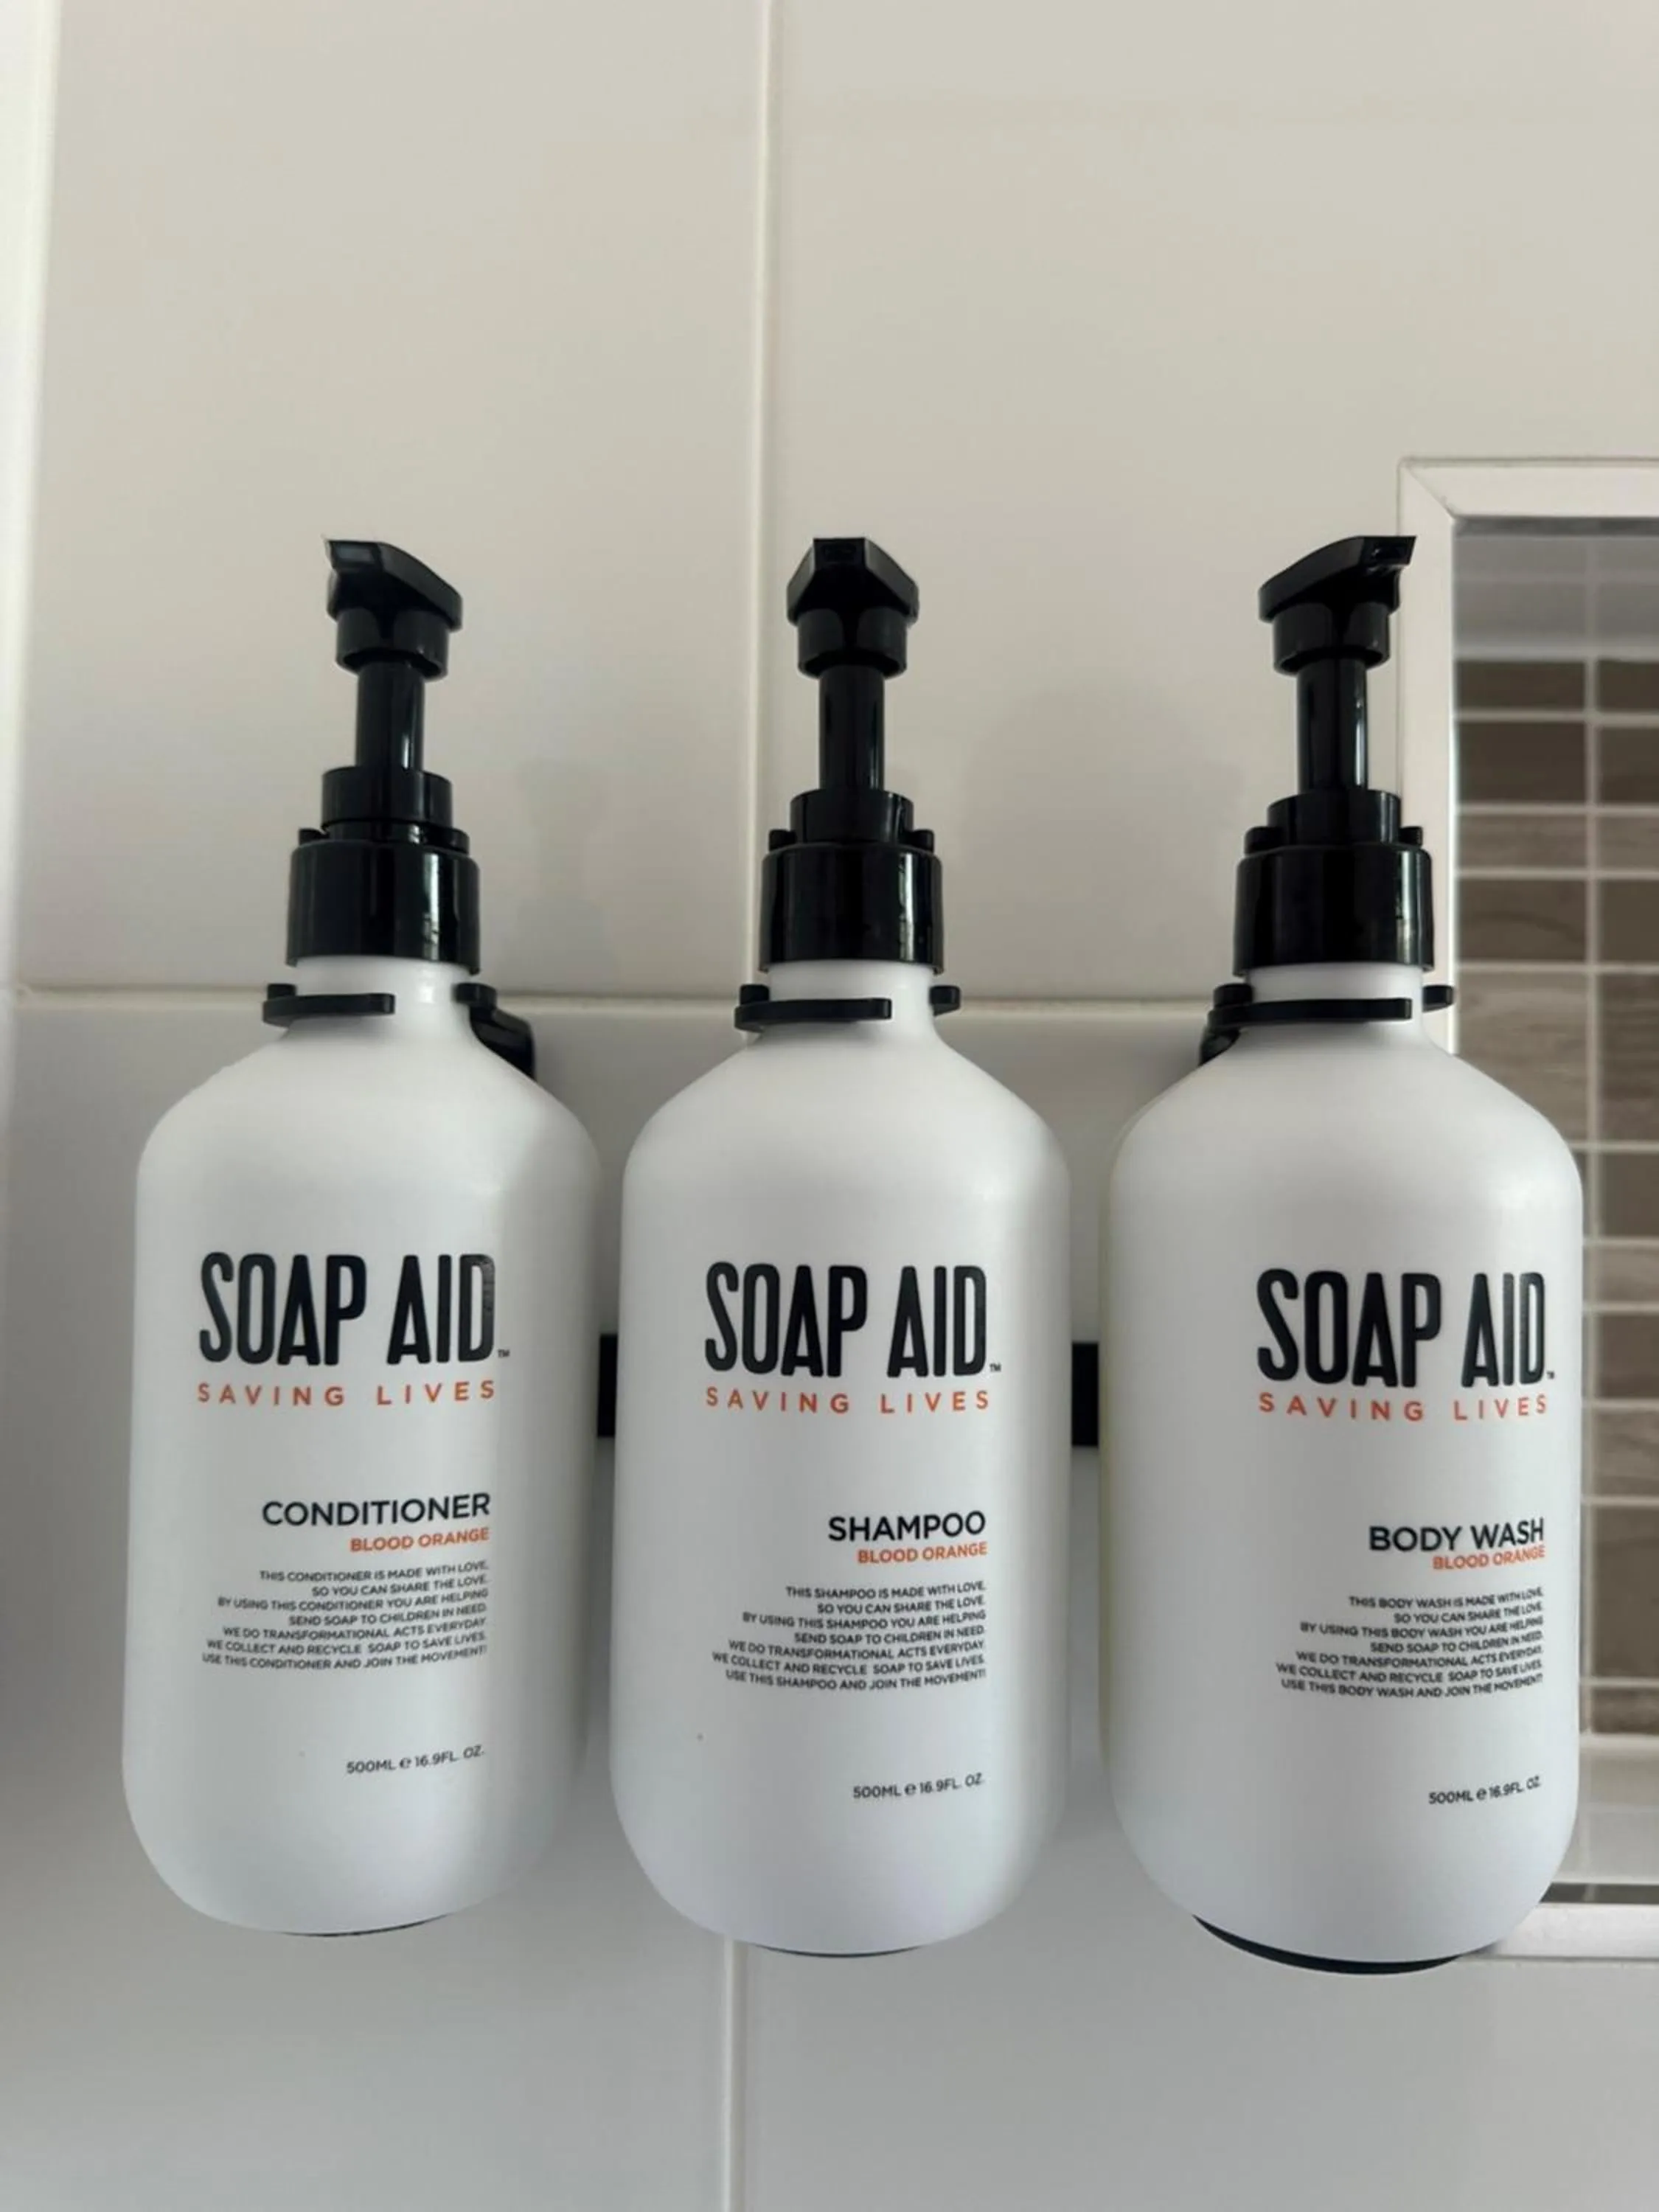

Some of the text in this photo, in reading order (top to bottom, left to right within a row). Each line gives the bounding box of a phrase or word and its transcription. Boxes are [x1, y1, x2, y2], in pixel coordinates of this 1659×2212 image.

[199, 1252, 366, 1366] SOAP
[386, 1253, 495, 1365] AID
[705, 1262, 867, 1377] SOAP
[887, 1265, 987, 1377] AID
[1257, 1268, 1545, 1388] SOAP AID
[198, 1380, 495, 1406] SAVING LIVES
[706, 1386, 989, 1414] SAVING LIVES
[1259, 1391, 1547, 1422] SAVING LIVES
[262, 1492, 491, 1526] CONDITIONER
[828, 1510, 986, 1542] SHAMPOO
[1369, 1517, 1543, 1552] BODY WASH
[350, 1527, 490, 1552] BLOOD ORANGE
[858, 1541, 988, 1564] BLOOD ORANGE
[1433, 1545, 1545, 1570] BLOOD ORANGE
[260, 1565, 455, 1582] THIS CONDITIONER IS MADE WITH
[311, 1586, 329, 1596] SO
[332, 1586, 358, 1596] YOU
[361, 1585, 387, 1596] CAN
[390, 1582, 429, 1594] SHARE
[434, 1579, 454, 1590] THE
[785, 1584, 955, 1599] THIS SHAMPOO IS MADE WITH
[218, 1587, 489, 1611] BY USING THIS CONDITIONER YOU ARE HELPING
[817, 1603, 834, 1614] SO
[837, 1604, 863, 1614] YOU
[865, 1603, 891, 1614] CAN
[894, 1601, 931, 1613] SHARE
[934, 1599, 954, 1610] THE
[1349, 1594, 1495, 1608] THIS BODY WASH MADE
[289, 1607, 453, 1626] SEND SOAP TO CHILDREN IN
[742, 1610, 986, 1630] BY USING THIS SHAMPOO YOU ARE HELPING
[1394, 1608, 1500, 1624] SO YOU CAN SHARE
[223, 1624, 425, 1640] WE DO TRANSFORMATIONAL ACTS
[794, 1628, 954, 1644] SEND SOAP TO CHILDREN IN
[1300, 1621, 1487, 1638] BY USING THIS BODY WASH YOU
[206, 1639, 223, 1649] WE
[224, 1641, 276, 1653] COLLECT
[277, 1644, 304, 1655] AND
[307, 1644, 361, 1655] RECYCLE
[368, 1641, 401, 1653] SOAP
[405, 1640, 420, 1650] TO
[422, 1635, 451, 1649] SAVE
[728, 1639, 927, 1659] WE DO TRANSFORMATIONAL ACTS
[1370, 1641, 1456, 1653] SEND SOAP TO
[202, 1652, 222, 1664] USE
[225, 1655, 248, 1666] THIS
[249, 1658, 331, 1669] CONDITIONER
[333, 1659, 361, 1669] AND
[364, 1657, 392, 1669] JOIN
[396, 1655, 418, 1665] THE
[712, 1651, 728, 1664] WE
[731, 1655, 781, 1671] COLLECT
[784, 1662, 810, 1673] AND
[813, 1664, 867, 1675] RECYCLE
[873, 1663, 905, 1674] SOAP
[908, 1662, 923, 1672] TO
[925, 1658, 953, 1671] SAVE
[1295, 1650, 1468, 1667] WE DO TRANSFORMATIONAL
[726, 1669, 746, 1682] USE
[749, 1672, 774, 1686] THIS
[776, 1676, 837, 1689] SHAMPOO
[839, 1680, 866, 1689] AND
[869, 1678, 897, 1690] JOIN
[900, 1677, 921, 1687] THE
[1275, 1661, 1494, 1683] WE COLLECT AND RECYCLE SOAP TO
[1281, 1678, 1470, 1697] USE THIS BODY WASH AND JOIN
[346, 1759, 396, 1774] 500ML
[853, 1784, 901, 1799] 500ML
[1428, 1790, 1473, 1804] 500ML
